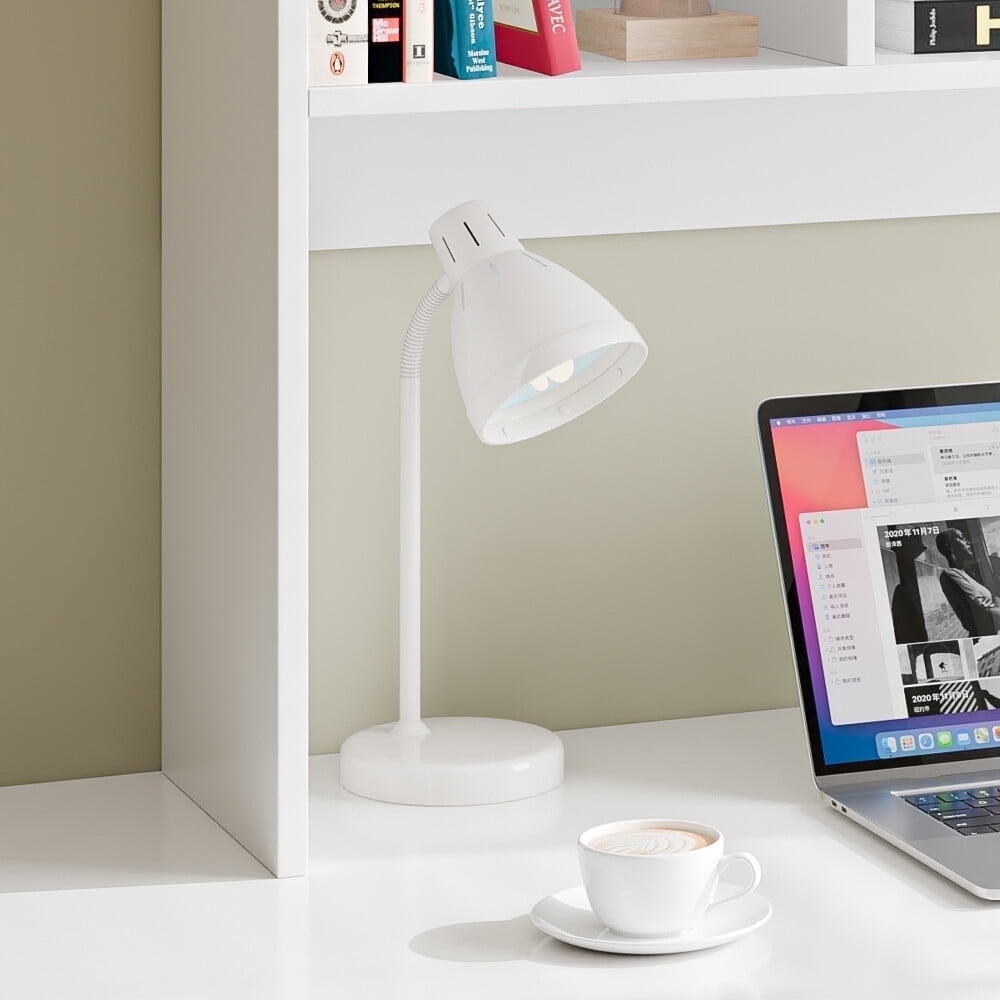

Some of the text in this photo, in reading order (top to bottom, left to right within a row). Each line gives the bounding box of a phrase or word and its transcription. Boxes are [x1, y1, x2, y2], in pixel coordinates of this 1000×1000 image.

[371, 2, 400, 10] THOMPSON
[884, 525, 940, 538] 2020年11月7日
